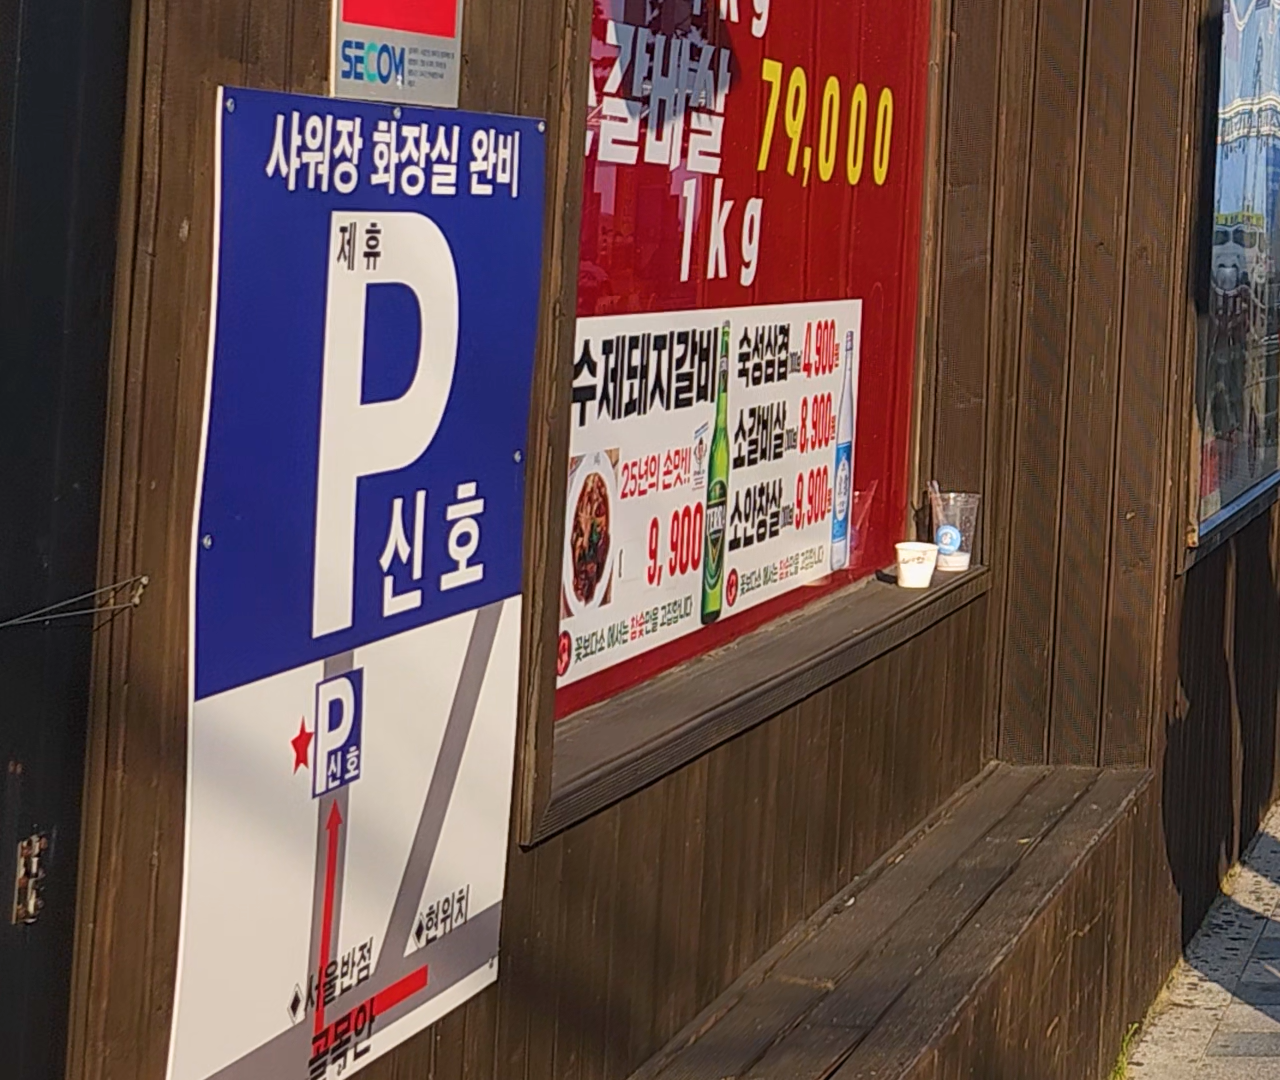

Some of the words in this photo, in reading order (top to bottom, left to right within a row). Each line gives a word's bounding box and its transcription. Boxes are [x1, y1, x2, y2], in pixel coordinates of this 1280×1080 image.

[265, 111, 363, 194] 샤워장
[370, 120, 460, 197] 화장실
[470, 128, 519, 198] 완비
[755, 58, 896, 188] 79,000
[336, 221, 382, 271] 제휴
[679, 177, 764, 287] 1kg
[571, 326, 720, 428] 수제돼지갈비
[311, 211, 460, 639] P
[732, 400, 786, 470] 소갈비살
[620, 453, 661, 500] 25년의
[379, 481, 485, 617] 신호
[647, 501, 704, 587] 9,900
[314, 676, 357, 794] P
[326, 746, 360, 788] 신호
[425, 884, 470, 946] 현위치
[304, 936, 374, 1014] 서울반점
